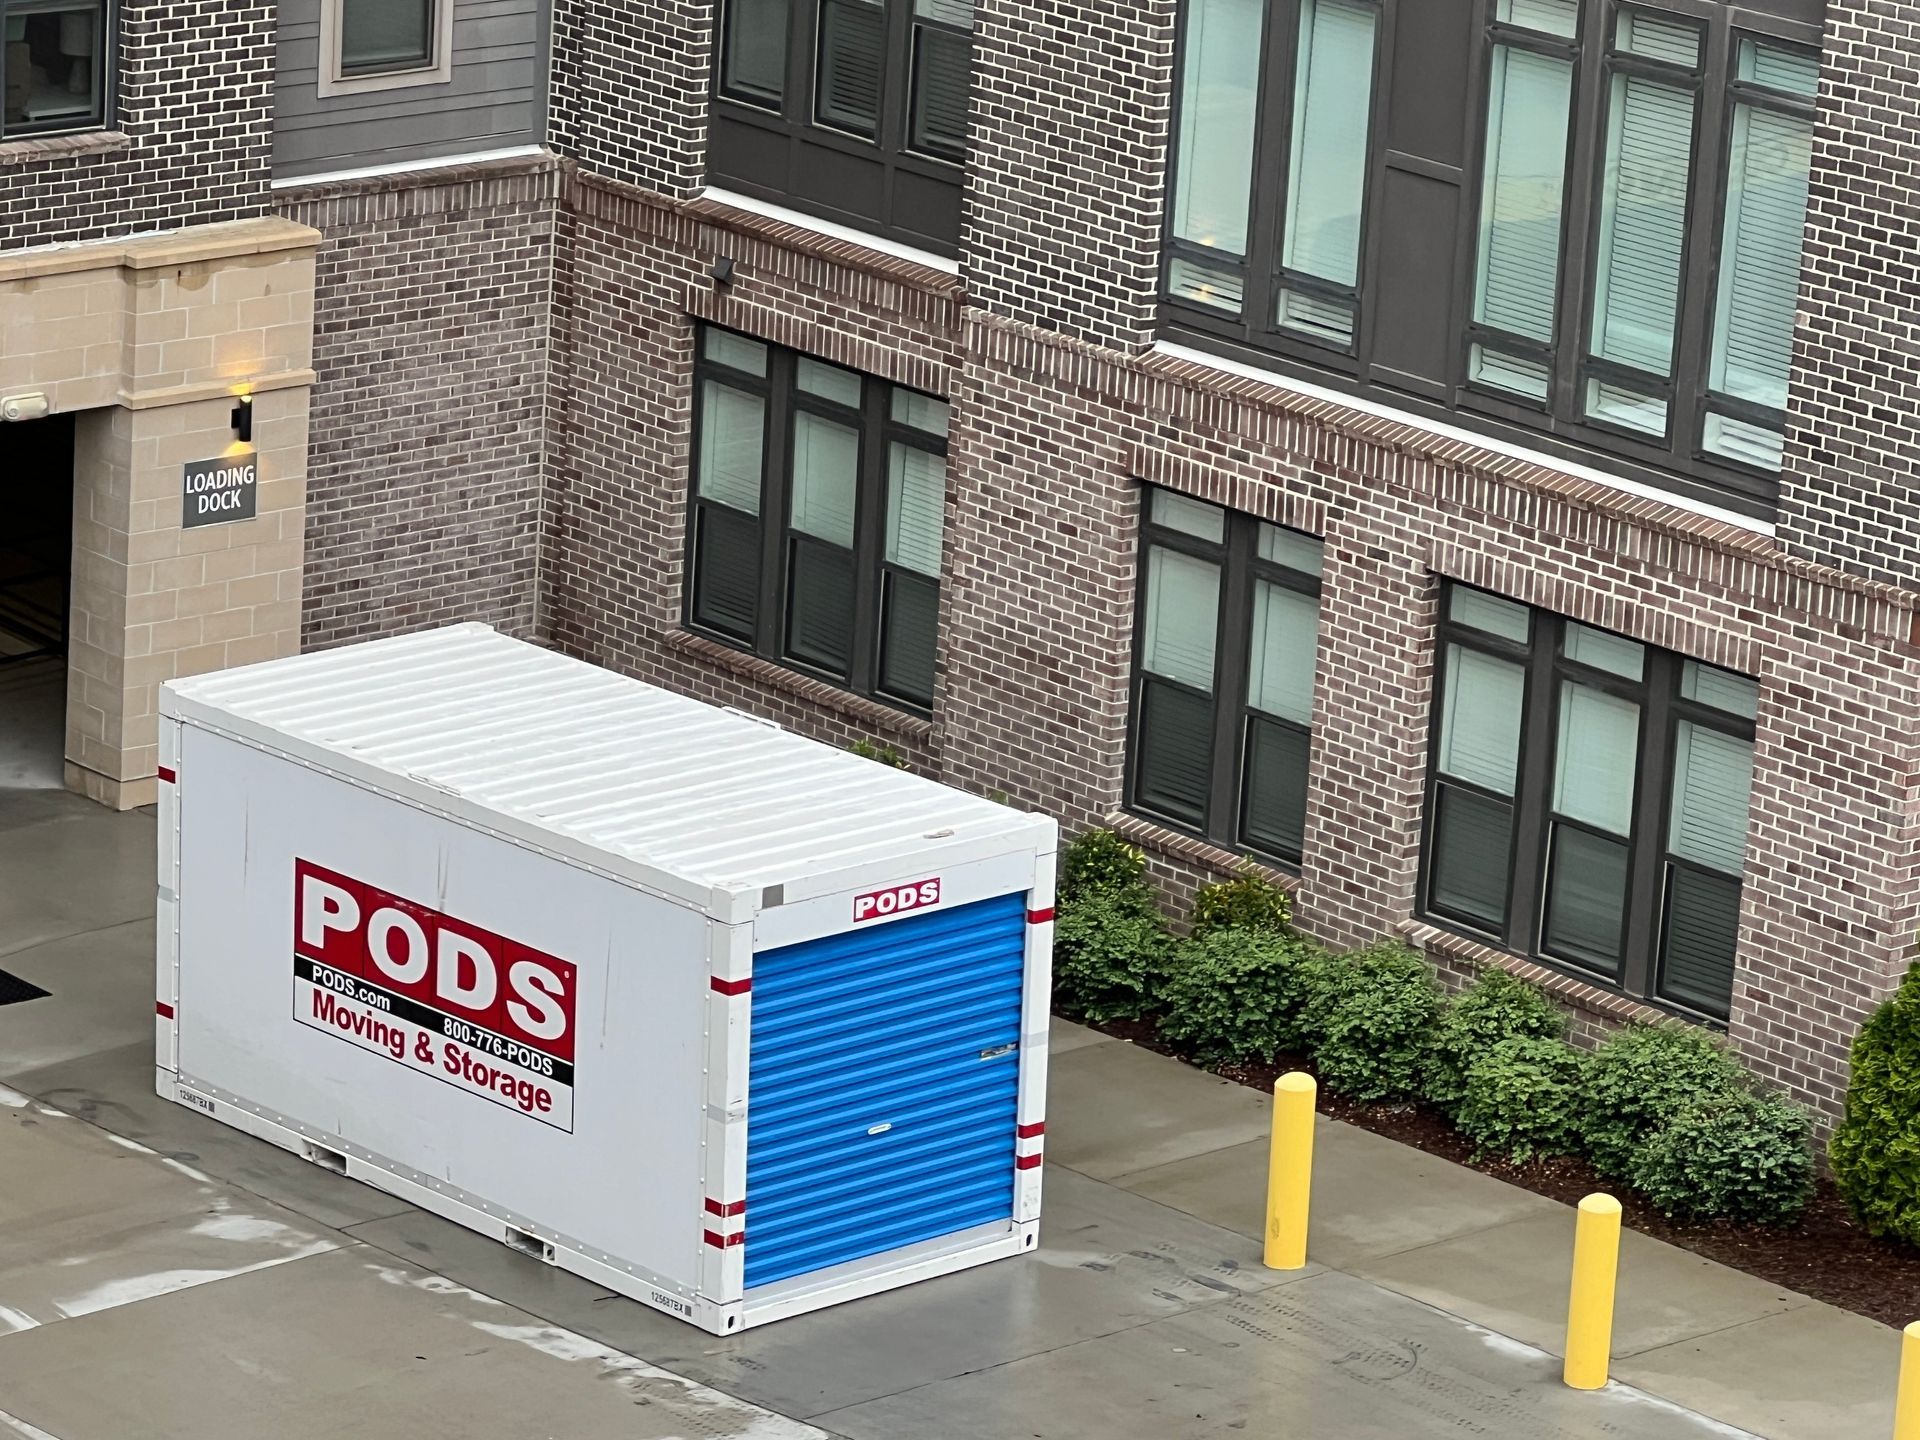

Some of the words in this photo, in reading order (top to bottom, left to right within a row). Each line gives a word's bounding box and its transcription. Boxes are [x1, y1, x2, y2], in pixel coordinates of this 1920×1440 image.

[186, 465, 254, 494] LOADING
[198, 489, 242, 514] DOCK
[855, 881, 939, 920] PODS
[302, 873, 567, 1040] PODS
[312, 965, 391, 1011] PODS.com
[443, 1017, 553, 1076] 800-776-PODS
[312, 987, 405, 1059] Moving
[414, 1030, 435, 1065] &
[443, 1042, 553, 1113] Storage
